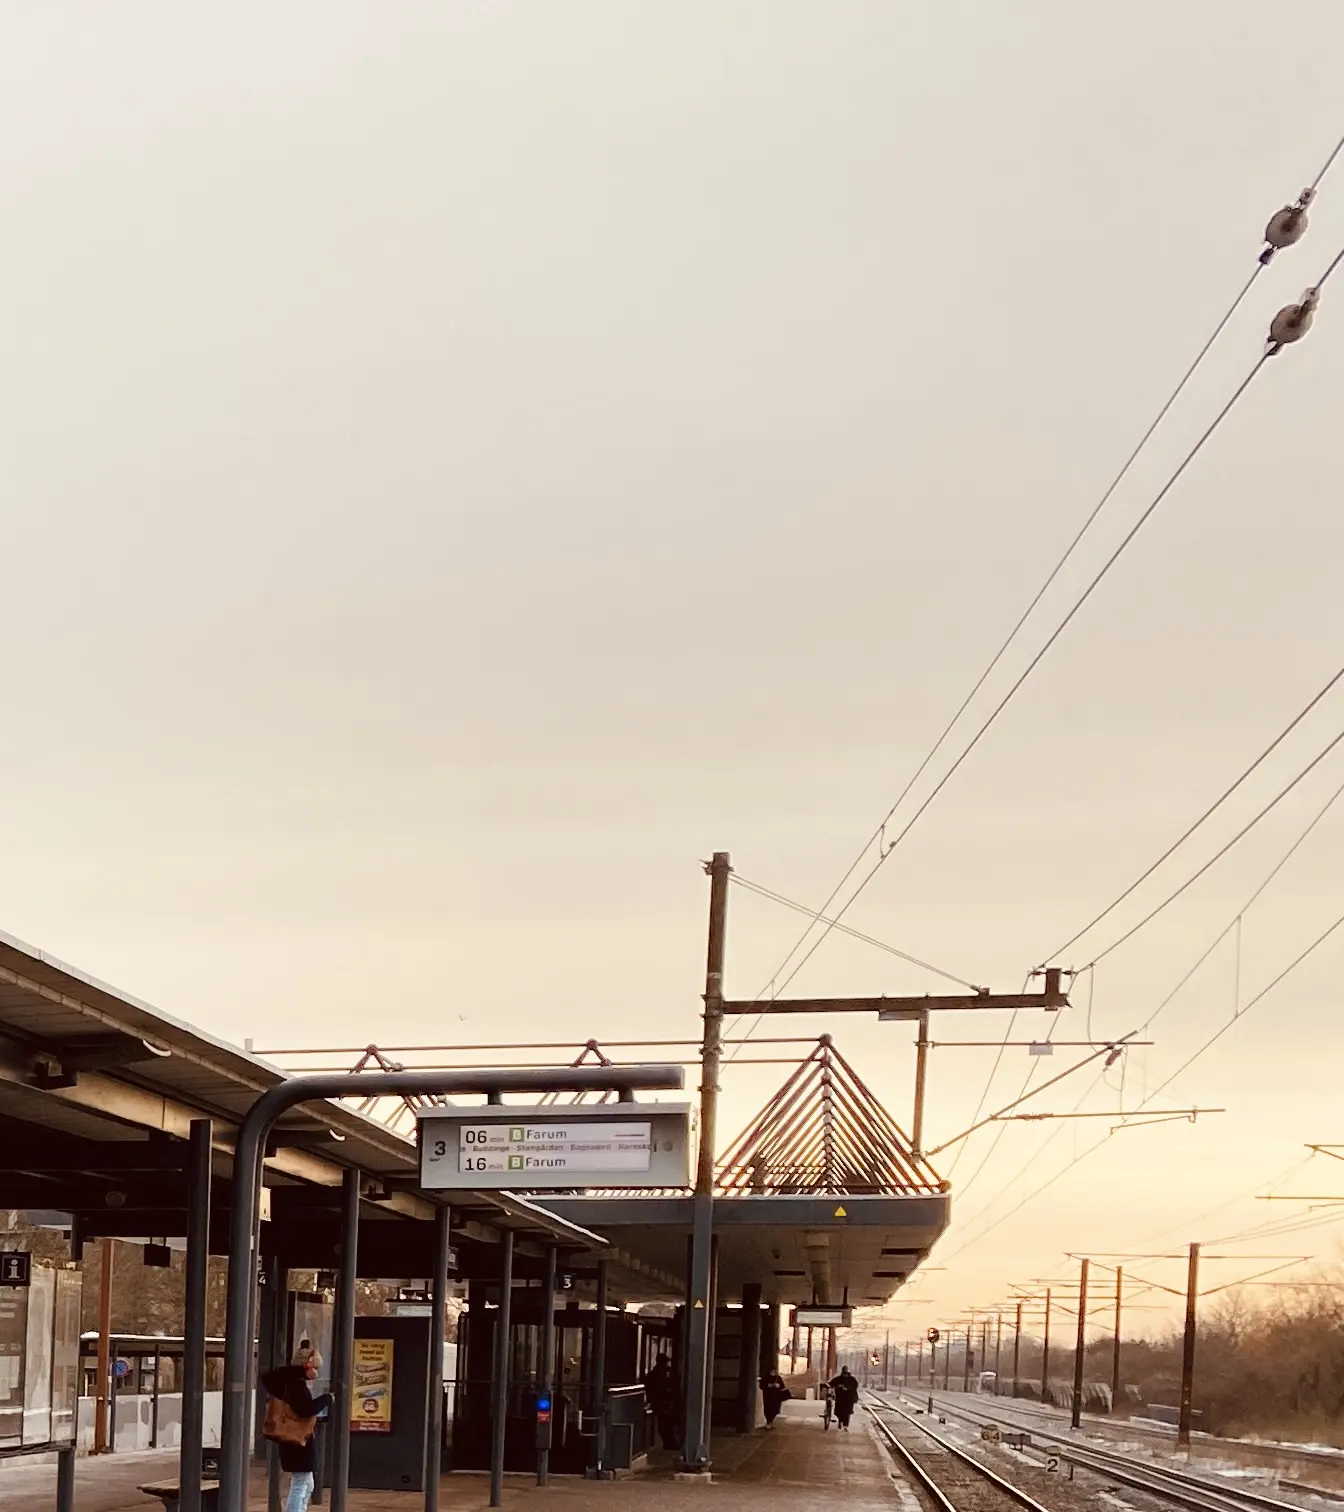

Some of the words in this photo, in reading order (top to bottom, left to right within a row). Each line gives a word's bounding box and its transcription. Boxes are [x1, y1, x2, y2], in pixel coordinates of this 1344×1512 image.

[465, 1130, 487, 1144] 06
[489, 1135, 505, 1143] min
[526, 1129, 567, 1140] Farum
[434, 1140, 447, 1156] 3
[464, 1157, 487, 1171] 16
[488, 1162, 504, 1170] min
[525, 1157, 567, 1168] Farum
[259, 1275, 266, 1285] 4
[563, 1278, 572, 1289] 3
[1046, 1458, 1059, 1473] 2
